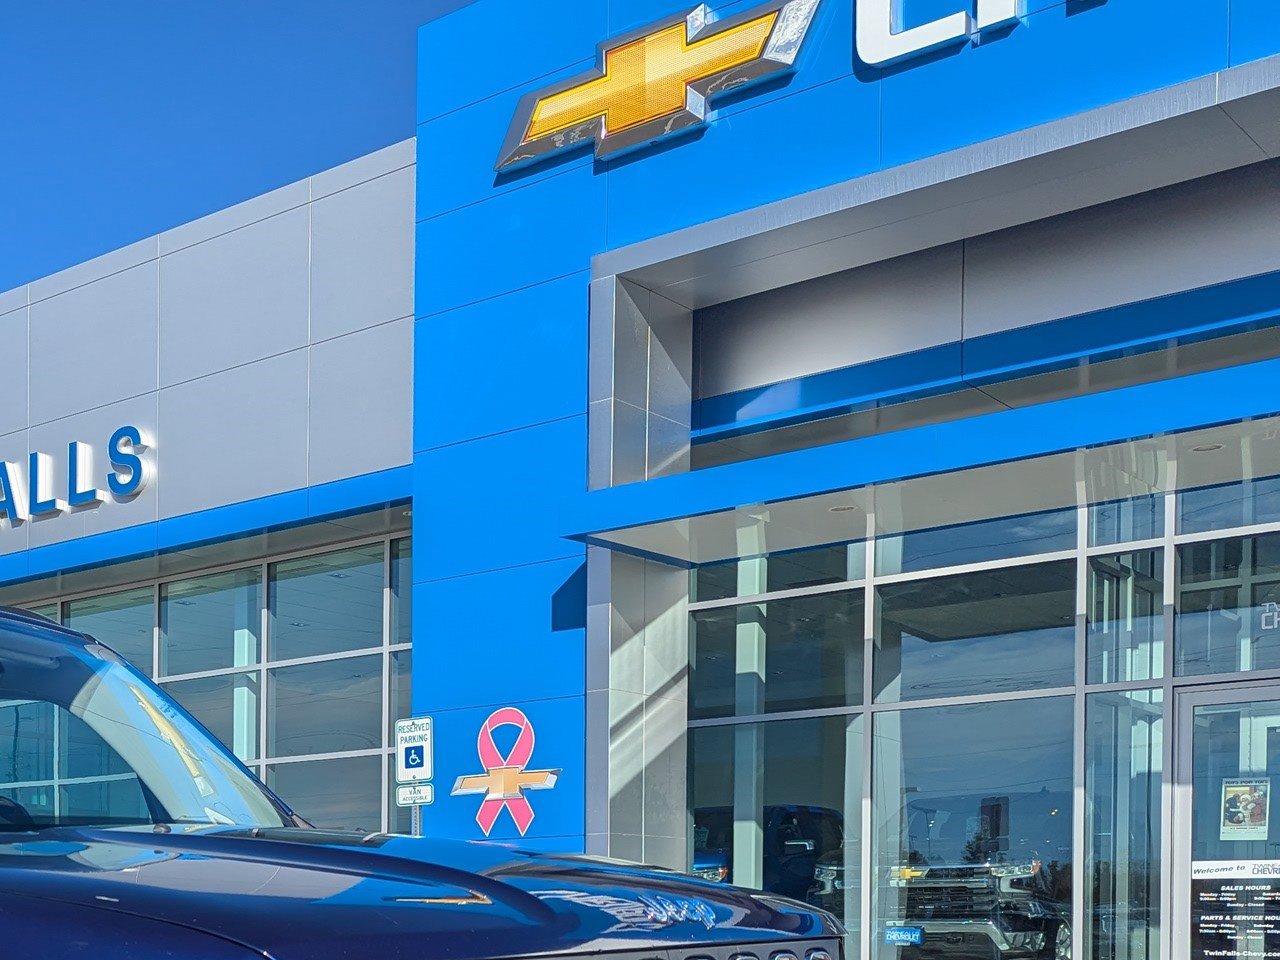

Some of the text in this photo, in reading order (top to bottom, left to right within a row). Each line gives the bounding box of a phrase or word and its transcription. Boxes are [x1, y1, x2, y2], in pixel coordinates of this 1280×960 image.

[399, 723, 430, 733] RESERVED
[400, 734, 428, 744] PARKING
[409, 788, 422, 796] VAN
[1193, 866, 1234, 875] Welcome
[637, 895, 716, 931] Jeep
